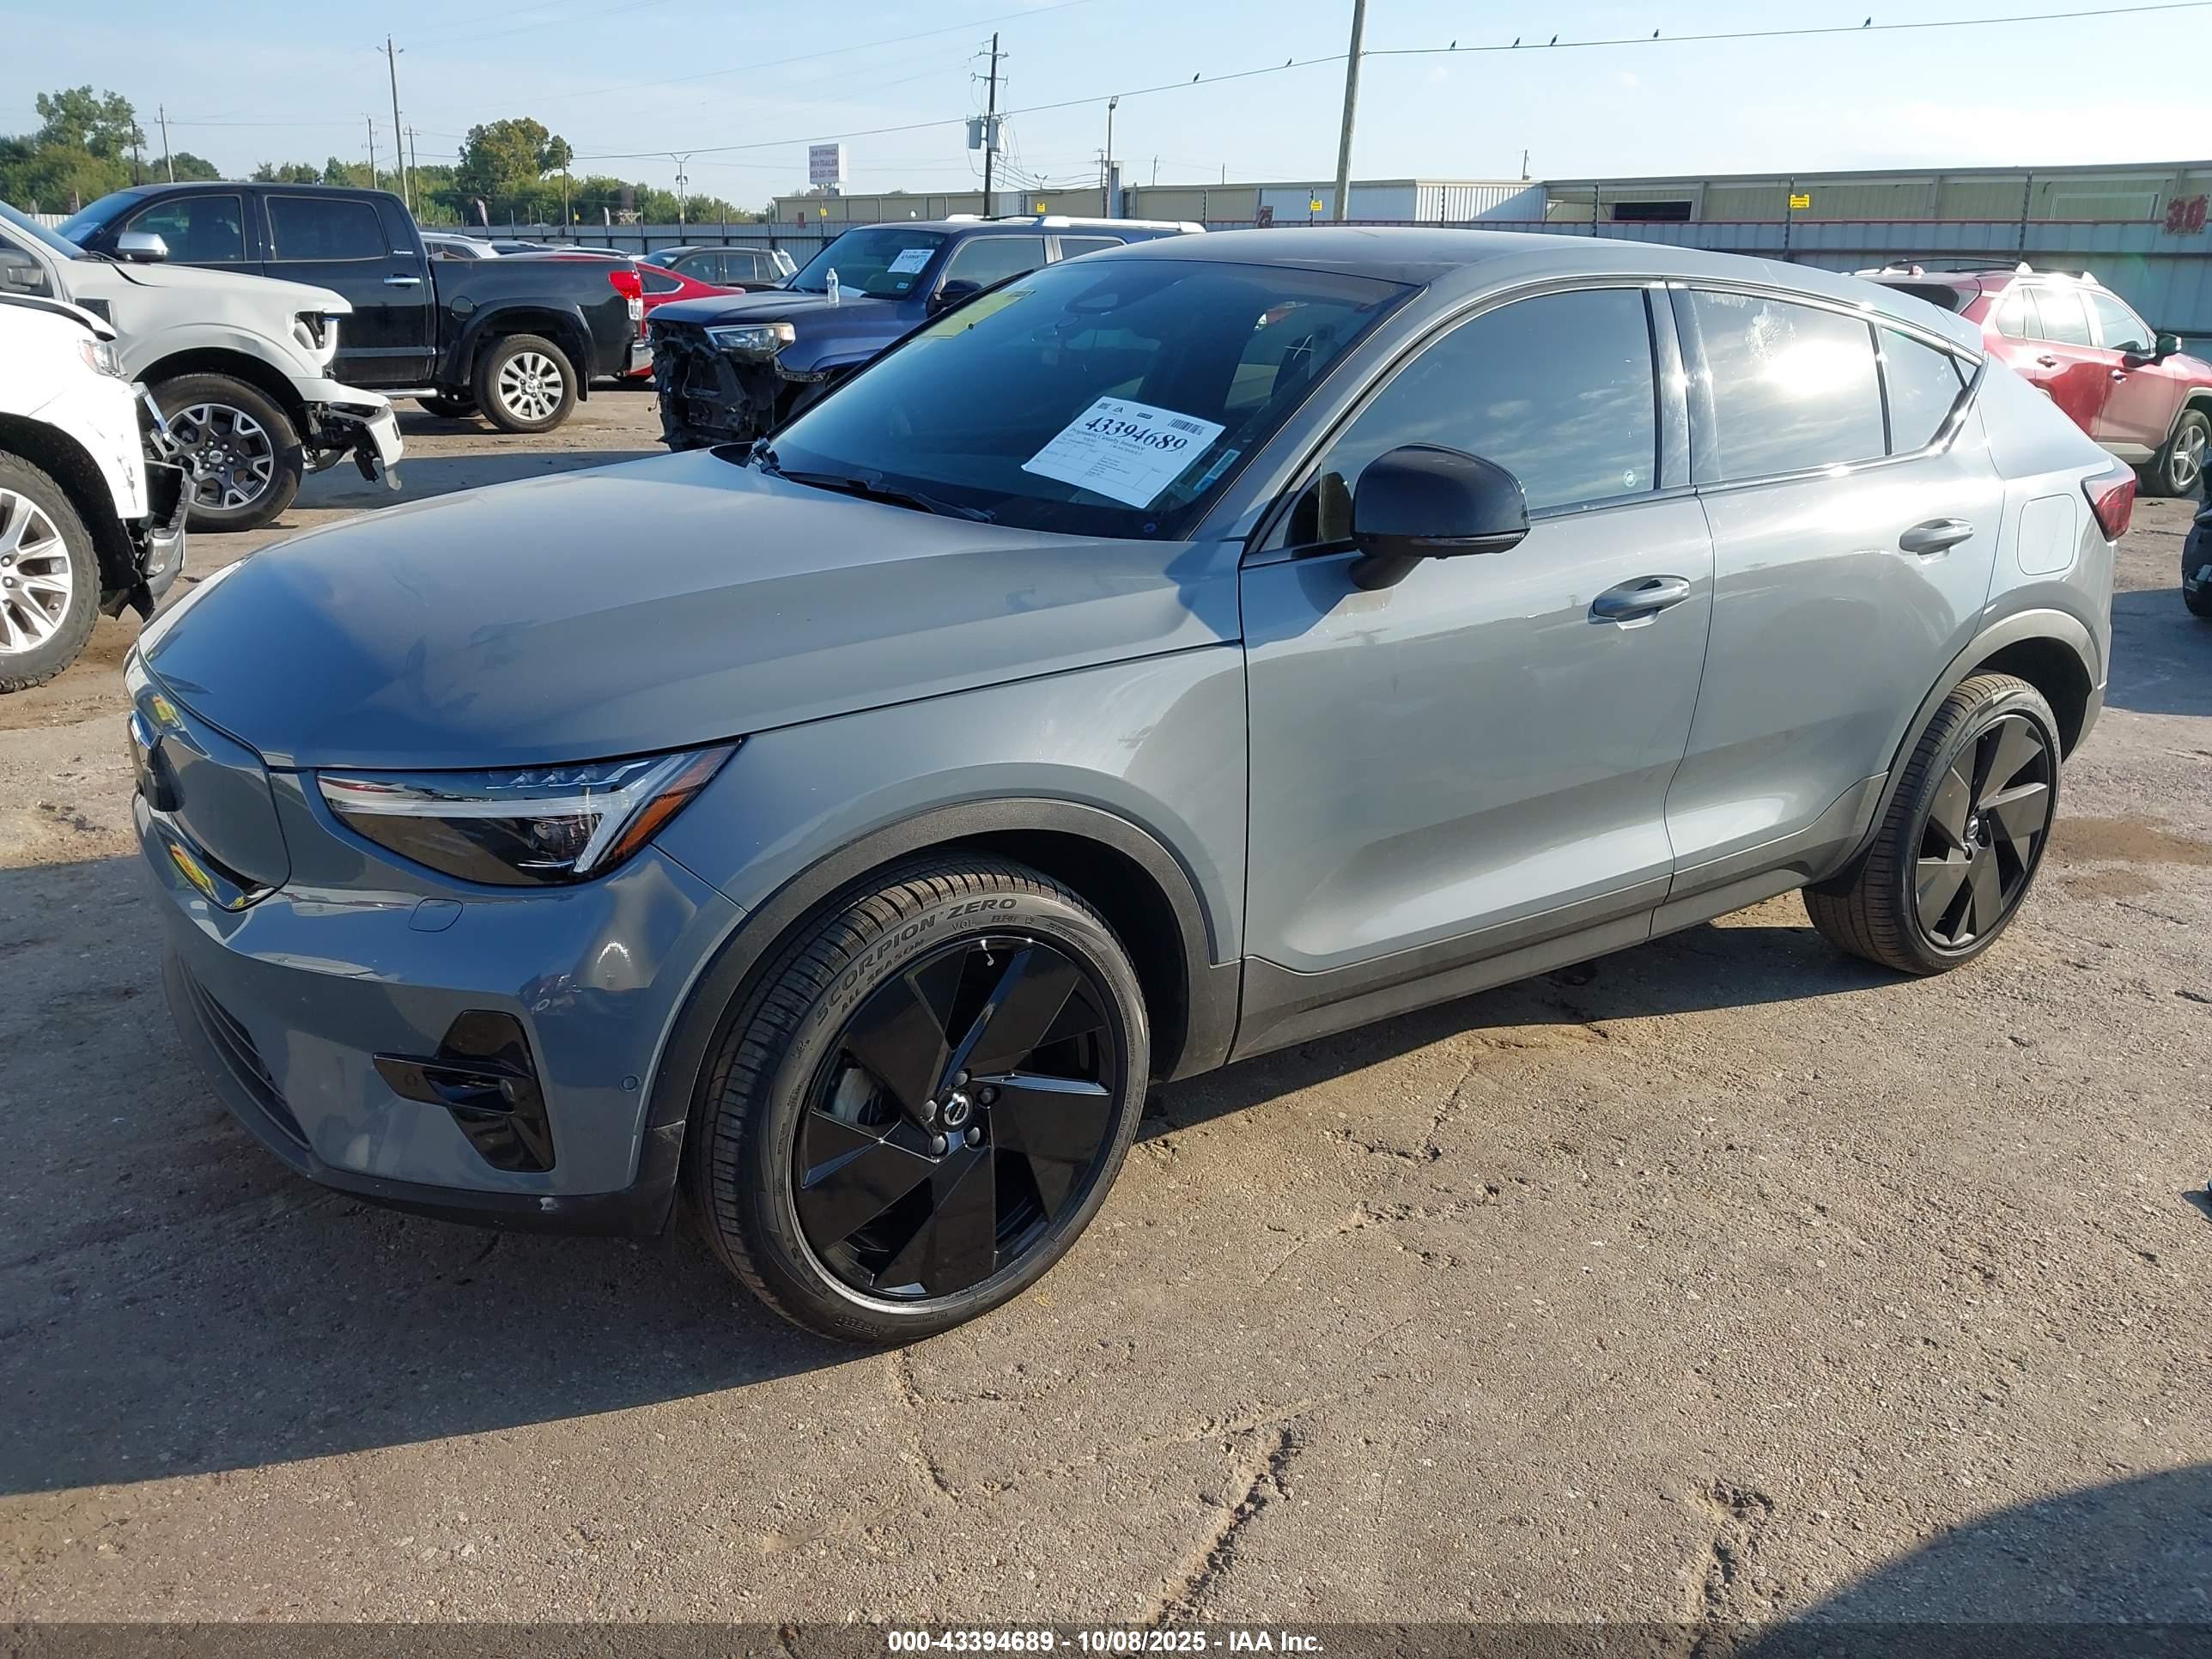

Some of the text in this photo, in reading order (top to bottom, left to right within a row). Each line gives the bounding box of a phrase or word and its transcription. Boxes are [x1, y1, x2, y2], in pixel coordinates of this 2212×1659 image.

[1085, 416, 1188, 453] 43394689
[816, 898, 1018, 1027] SCORPION ZERO
[841, 938, 926, 1014] ALL SEASON
